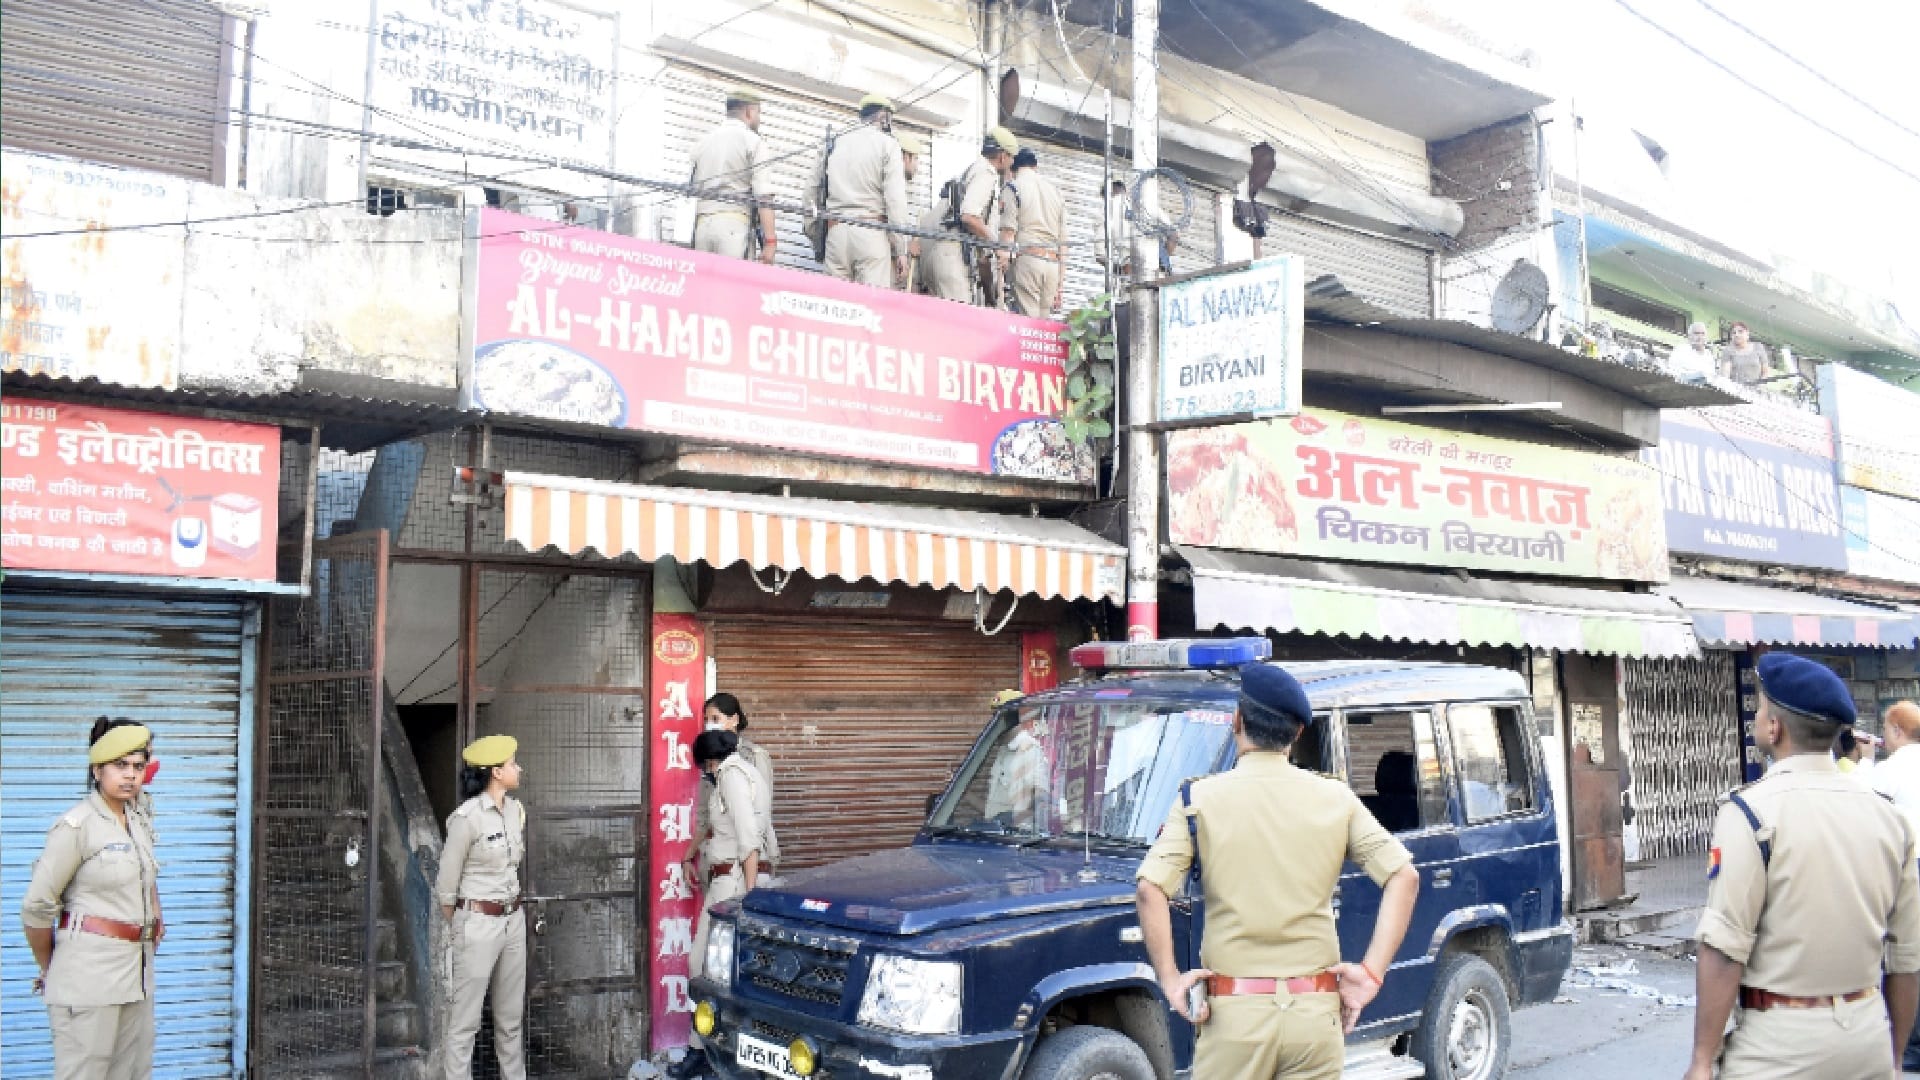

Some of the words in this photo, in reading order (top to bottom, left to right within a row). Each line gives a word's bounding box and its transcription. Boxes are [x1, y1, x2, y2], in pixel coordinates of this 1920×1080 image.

[519, 247, 604, 285] Biryani
[608, 264, 685, 298] Special
[1168, 295, 1197, 329] AL
[1201, 277, 1280, 325] NAWAZ
[507, 283, 733, 366] AL-HAMD
[749, 325, 925, 397] CHICKEN
[1179, 354, 1265, 387] BIRYANI
[671, 407, 704, 427] Shop
[1440, 442, 1459, 461] की
[1704, 446, 1786, 529] SCHOOL
[1782, 463, 1840, 537] DRESS
[1315, 505, 1430, 552] चिकन
[1440, 519, 1566, 563] बिरयानी
